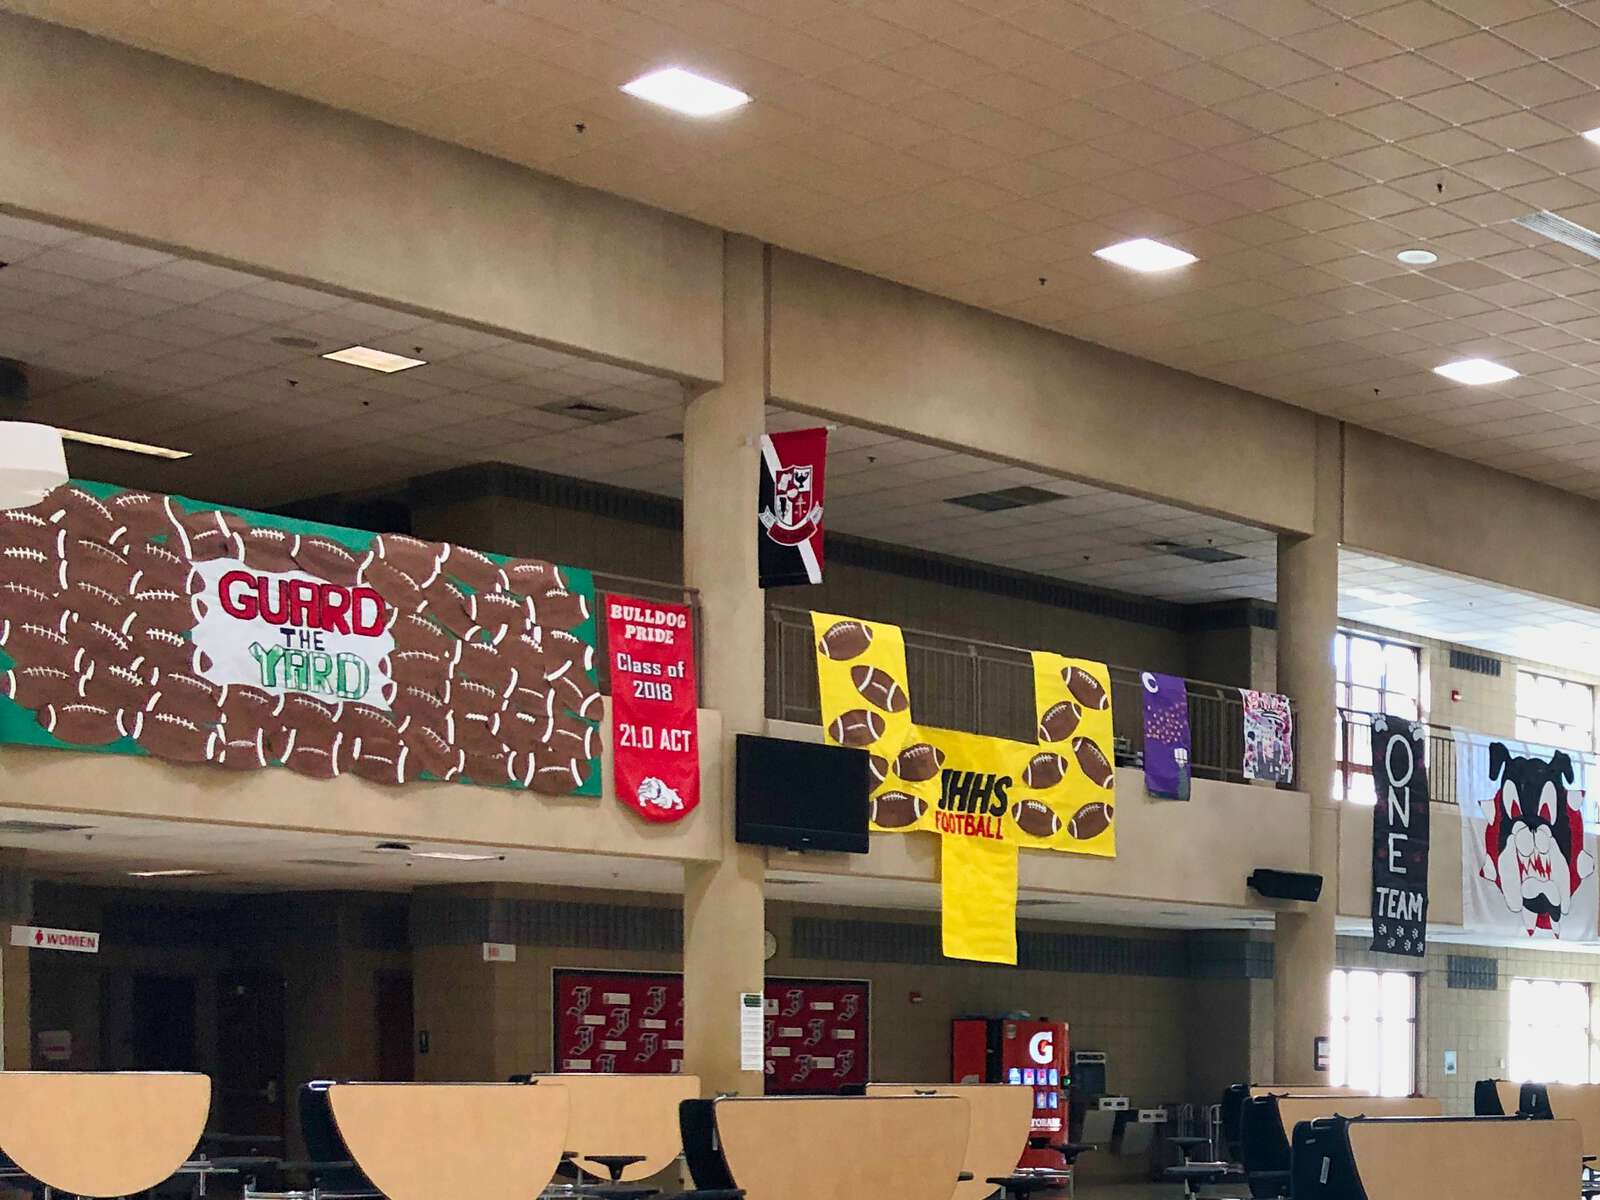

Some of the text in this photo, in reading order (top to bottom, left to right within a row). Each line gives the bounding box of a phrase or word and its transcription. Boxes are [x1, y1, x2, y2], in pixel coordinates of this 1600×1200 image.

[218, 570, 386, 637] GUARD
[610, 604, 687, 629] BULLDOG
[280, 627, 326, 651] THE
[624, 624, 674, 645] PRIDE
[248, 641, 370, 700] YARD
[616, 652, 685, 678] Class of
[632, 680, 673, 701] 2018
[619, 723, 692, 752] 21.0 ACT
[1385, 734, 1414, 874] ONE
[935, 810, 1004, 840] FOOTBALL
[1376, 886, 1424, 922] TEAM
[47, 933, 96, 948] WOMEN
[1029, 1031, 1053, 1064] G
